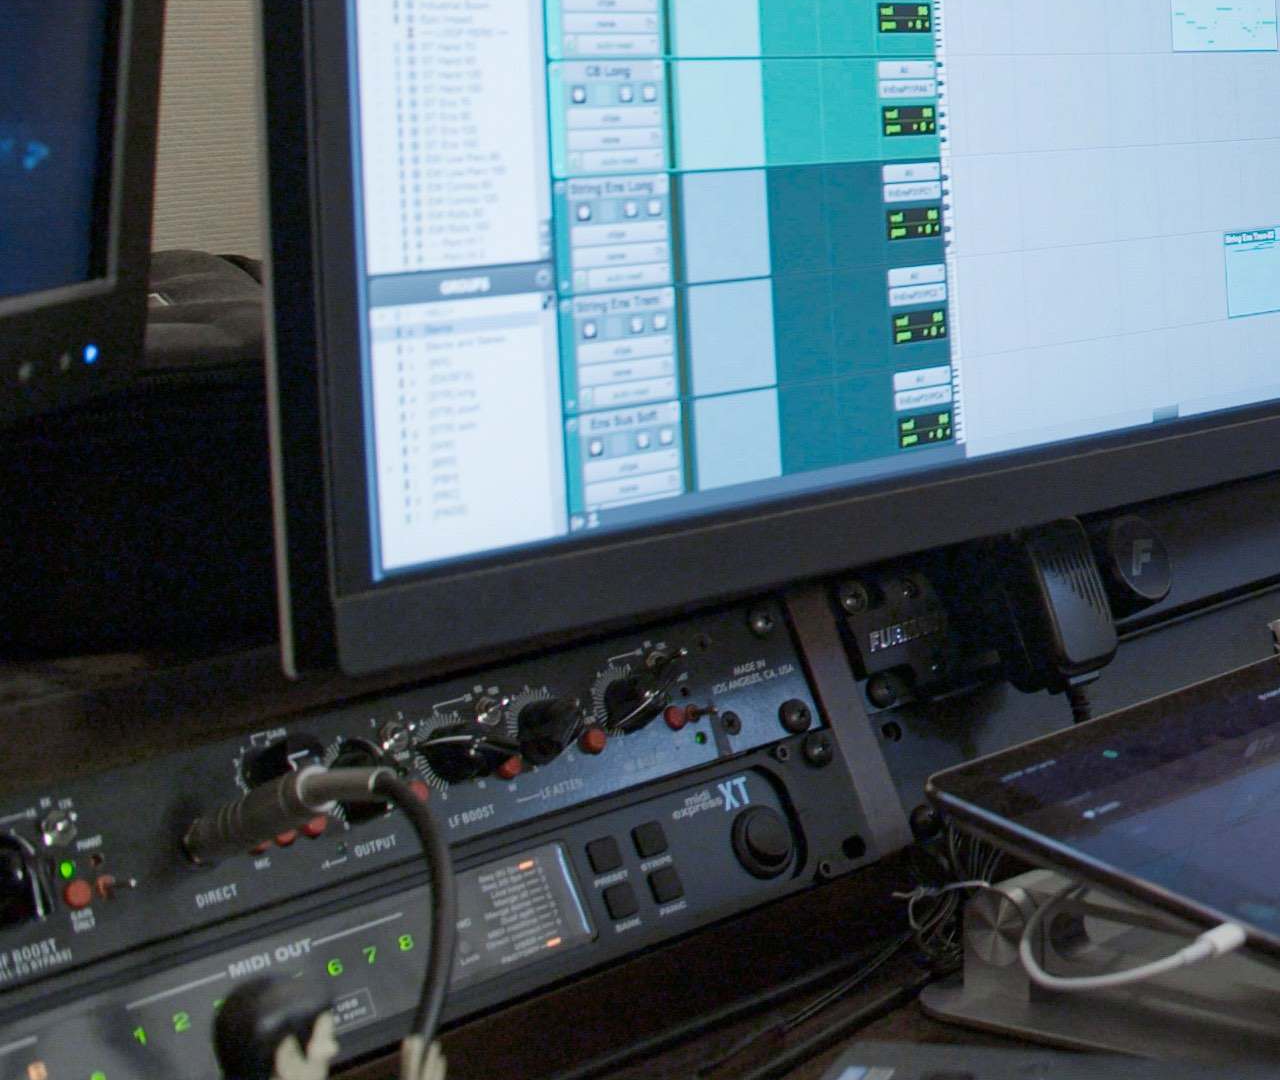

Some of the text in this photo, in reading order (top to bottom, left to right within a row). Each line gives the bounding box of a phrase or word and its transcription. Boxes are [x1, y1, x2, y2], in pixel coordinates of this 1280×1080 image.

[586, 65, 631, 78] CB Long
[606, 182, 624, 193] Ens
[628, 180, 653, 193] Long
[684, 789, 711, 806] midi
[718, 776, 750, 812] XT
[447, 803, 495, 829] LF BOOST
[672, 796, 723, 820] express
[354, 834, 397, 859] OUTPUT
[254, 857, 271, 870] MIC
[195, 883, 238, 909] DIRECT
[12, 938, 56, 964] BOOST
[398, 934, 414, 952] 8
[228, 937, 312, 978] MIDI OUT
[363, 946, 377, 965] 7
[327, 958, 343, 977] 6
[337, 998, 359, 1012] USB
[173, 1011, 191, 1033] 2
[133, 1026, 147, 1045] 1
